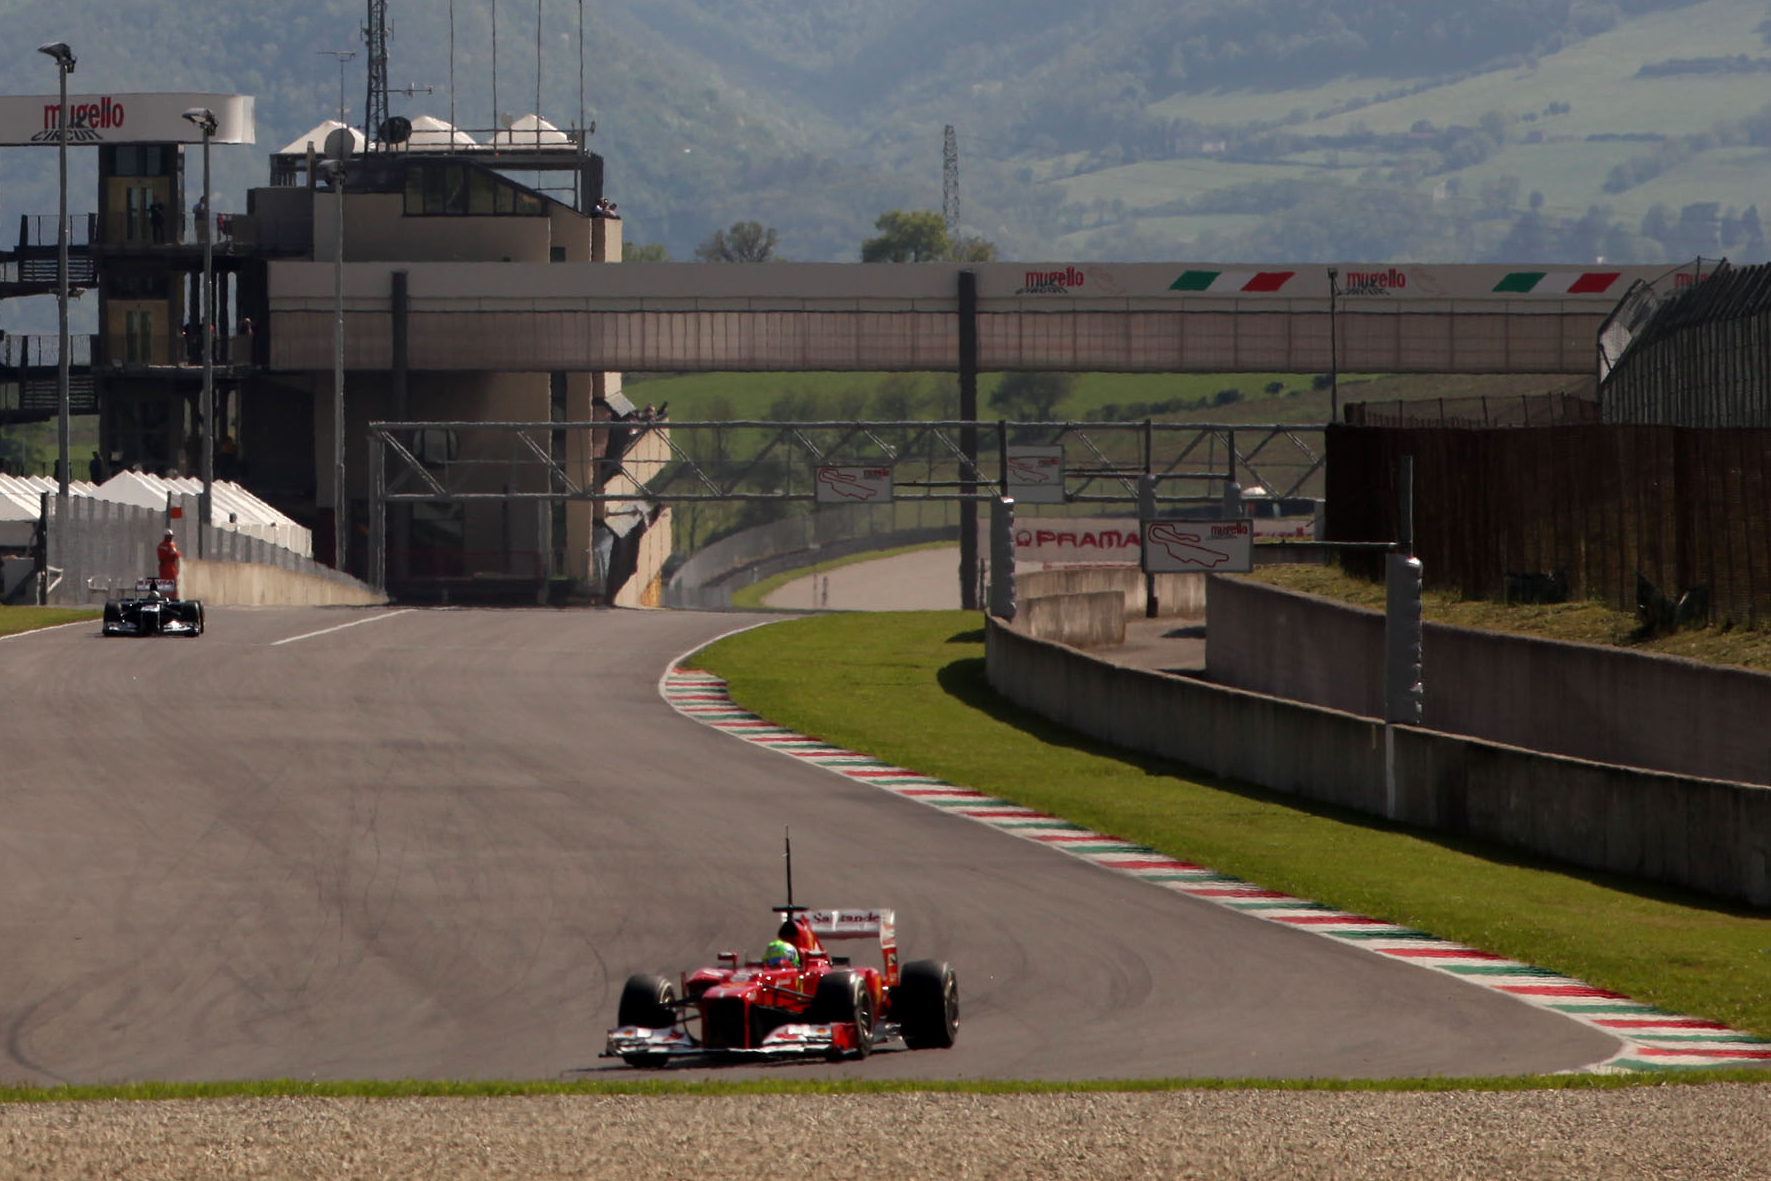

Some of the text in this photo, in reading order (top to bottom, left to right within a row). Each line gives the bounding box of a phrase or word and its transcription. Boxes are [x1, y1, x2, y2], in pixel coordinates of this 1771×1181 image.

[44, 96, 124, 130] mugello
[31, 129, 103, 141] CIRCUIT
[1025, 267, 1084, 287] mugello
[1347, 267, 1406, 288] mugello
[1036, 530, 1140, 548] PRAMA
[813, 912, 881, 923] Satande
